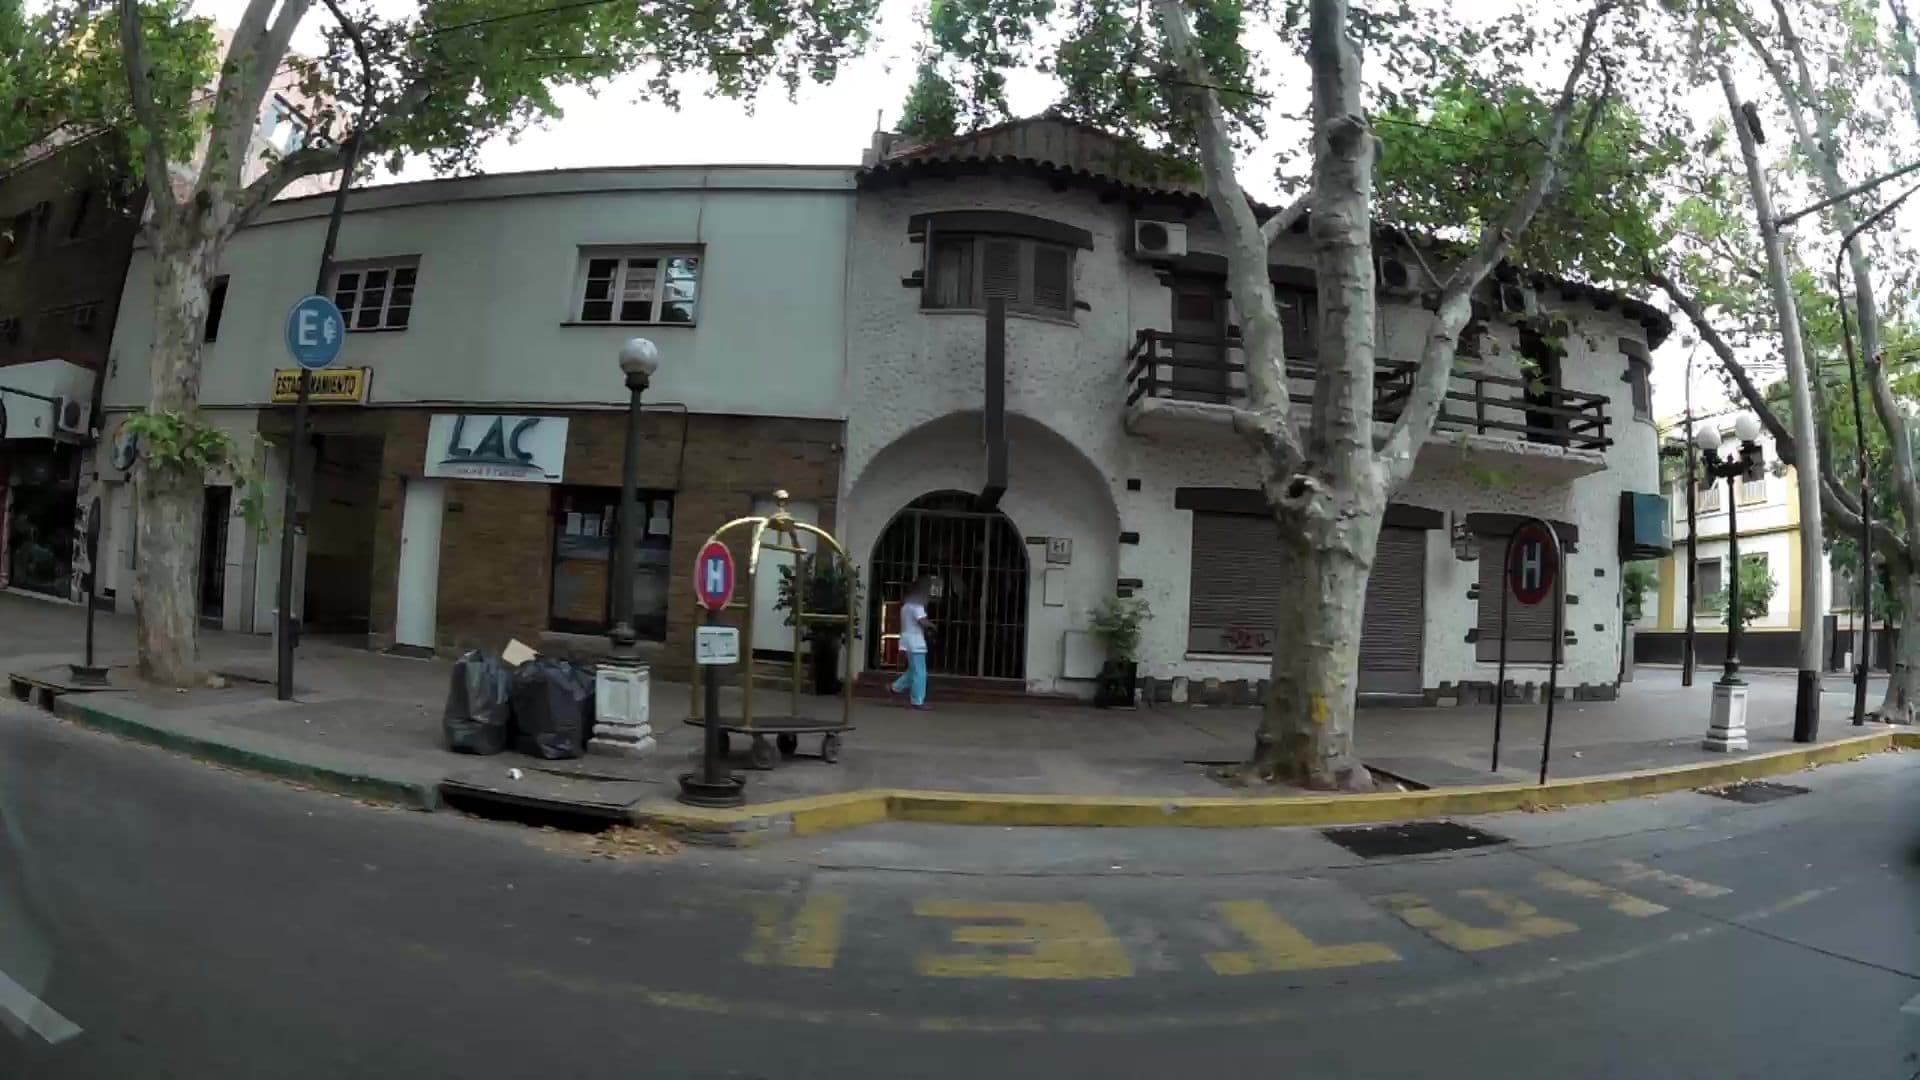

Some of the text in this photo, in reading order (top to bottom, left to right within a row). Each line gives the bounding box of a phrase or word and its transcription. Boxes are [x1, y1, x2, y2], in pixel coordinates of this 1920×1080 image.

[448, 415, 541, 460] LAC
[706, 559, 725, 593] H
[1521, 542, 1541, 590] H
